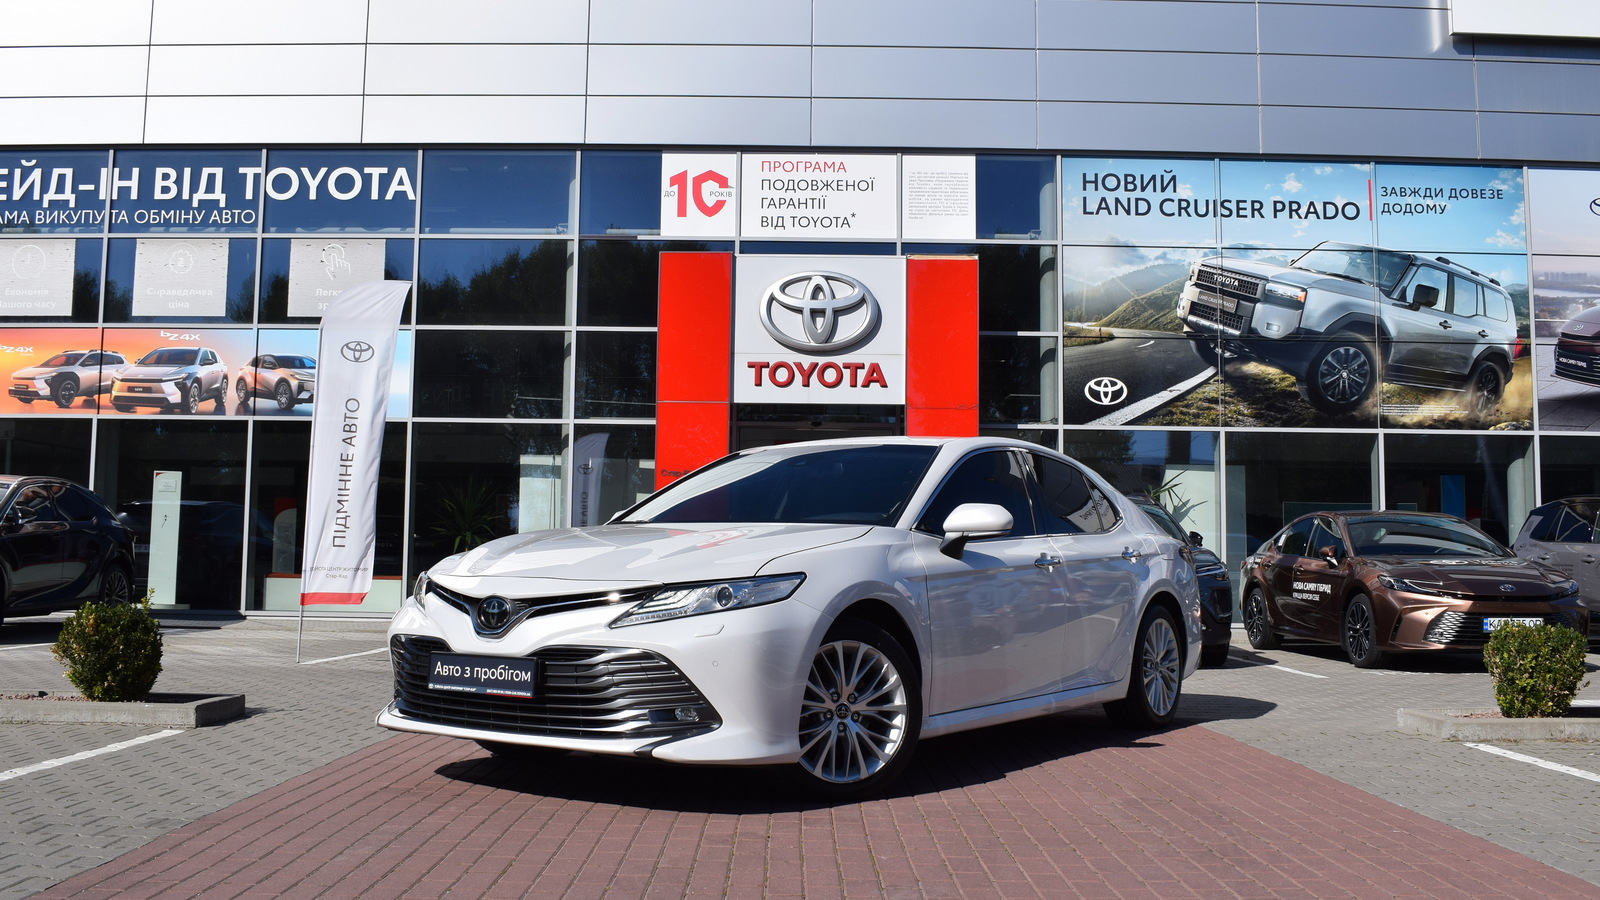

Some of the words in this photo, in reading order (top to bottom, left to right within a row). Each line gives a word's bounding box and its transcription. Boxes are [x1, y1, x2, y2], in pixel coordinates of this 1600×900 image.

[761, 160, 847, 173] ПРОГРАМА
[154, 167, 226, 208] ВІД
[239, 167, 416, 201] TOYOTA
[761, 176, 875, 194] ПОДОВЖЕНОЇ
[1082, 169, 1178, 194] НОВИЙ
[664, 190, 676, 198] ДО
[709, 190, 733, 198] РОКІВ
[761, 194, 827, 211] ГАРАНТІЇ
[1380, 186, 1444, 201] ЗАВЖДИ
[1448, 186, 1504, 202] ДОВЕЗЕ
[0, 210, 30, 225] МА
[35, 210, 105, 226] ВИКУПУ
[111, 209, 129, 224] ТА
[134, 208, 206, 225] ОБМІНУ
[208, 208, 257, 225] АВТО
[1082, 198, 1152, 218] LAND
[1158, 198, 1266, 220] CRUISER
[1272, 200, 1361, 221] PRADO
[1380, 202, 1447, 217] ДОДОМУ
[760, 214, 786, 231] ВІД
[1214, 275, 1238, 286] TOYOTA
[146, 287, 213, 297] Справедлива
[34, 301, 57, 310] часу
[168, 299, 190, 309] ціна
[747, 361, 888, 388] TOYOTA
[341, 397, 360, 447] АВТО
[332, 452, 355, 548] ПІДМІННЕ
[434, 661, 462, 677] Авто
[464, 667, 471, 677] з
[473, 665, 531, 682] пробігом
